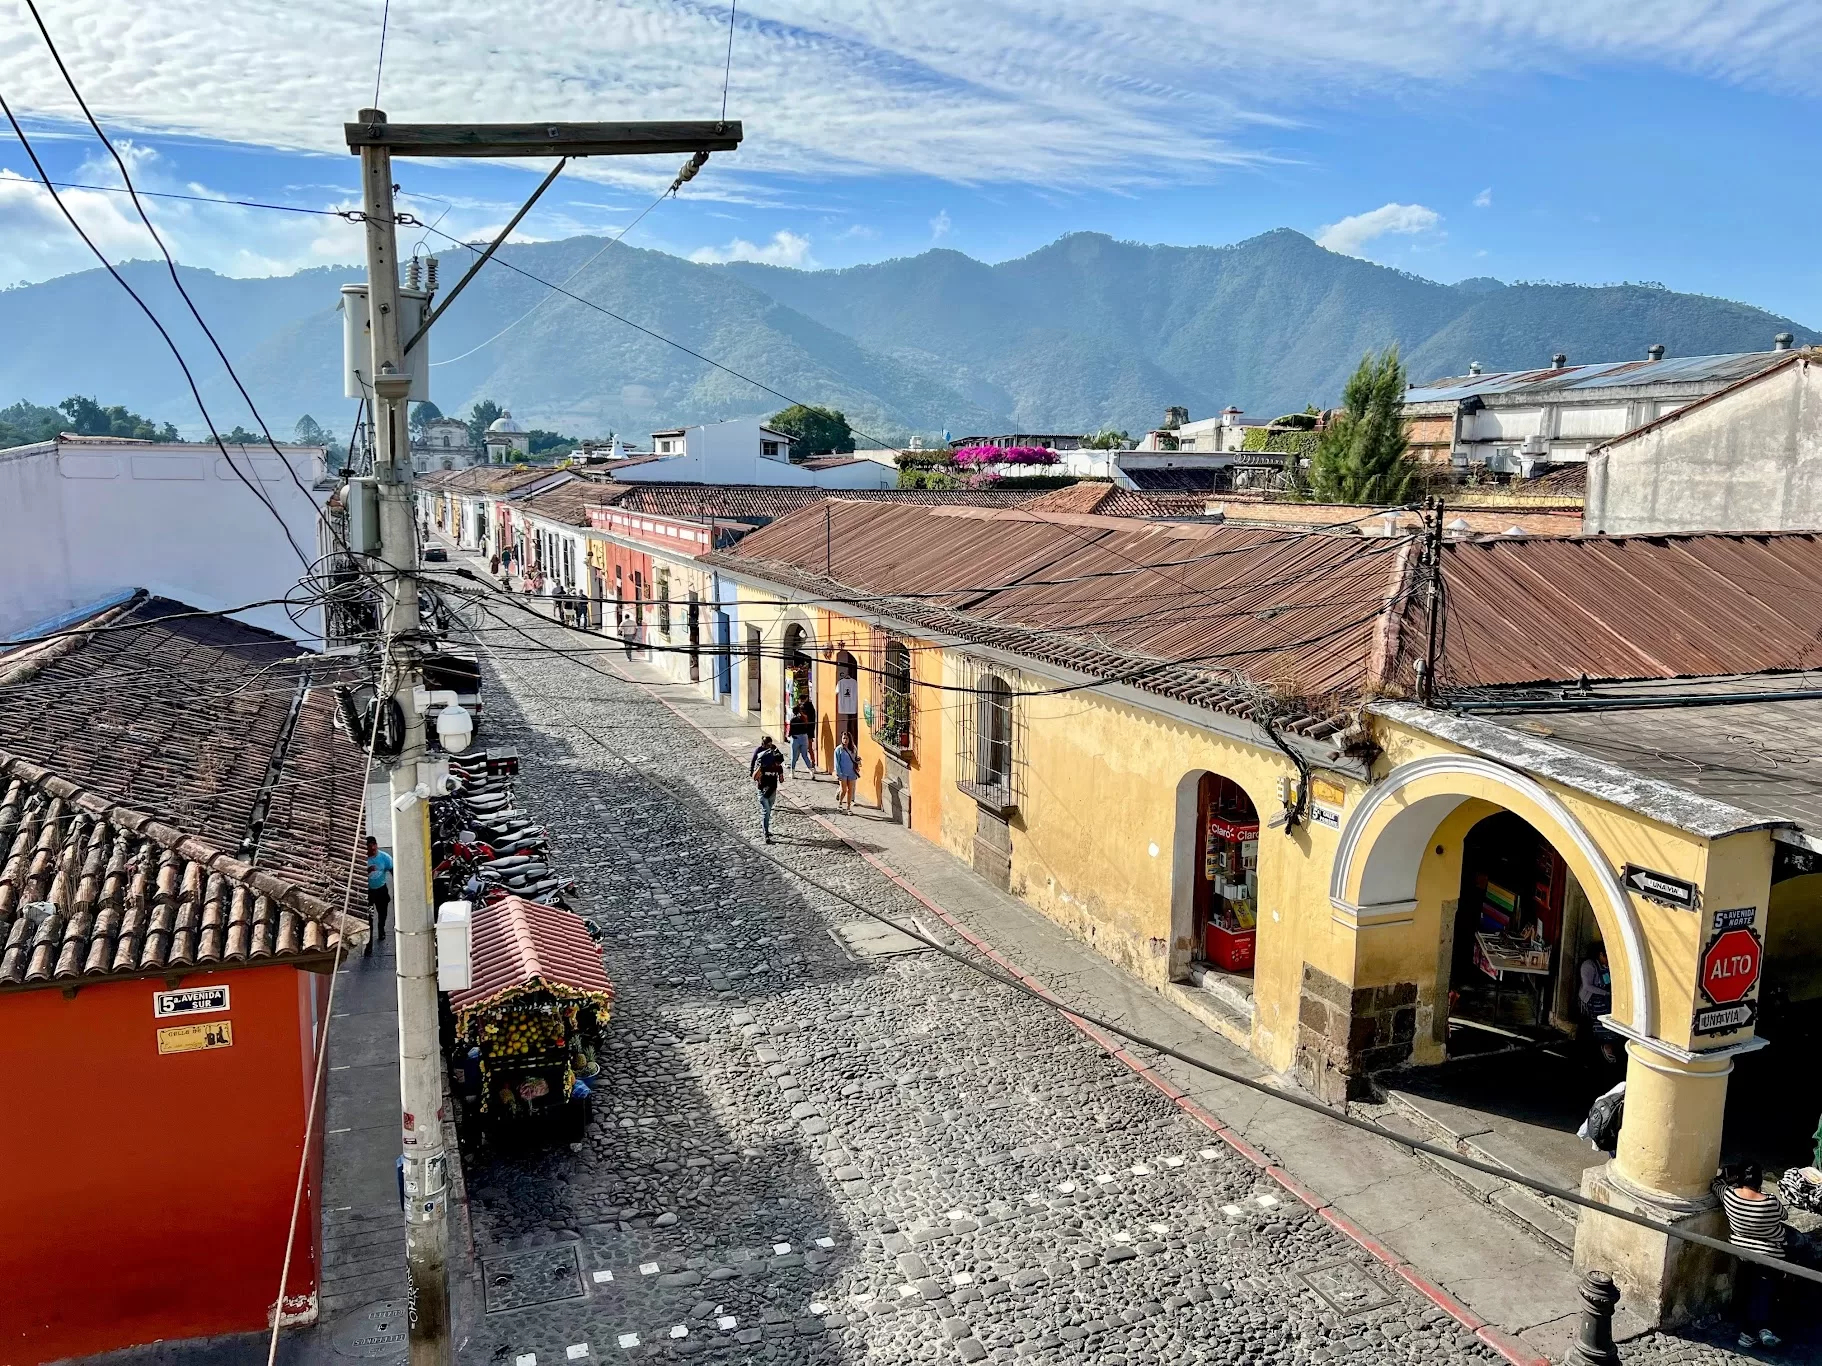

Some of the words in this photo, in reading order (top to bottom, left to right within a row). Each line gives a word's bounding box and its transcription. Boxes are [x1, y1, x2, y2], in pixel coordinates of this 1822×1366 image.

[1211, 823, 1231, 838] Claro
[1652, 881, 1666, 890] UNA
[1667, 886, 1678, 894] VIA
[1728, 909, 1754, 919] AVENIDA
[1728, 917, 1752, 927] NORTE
[1710, 954, 1752, 980] ALTO
[181, 991, 221, 1002] AVENIDA
[192, 1000, 212, 1009] SUR
[1703, 1013, 1721, 1027] UNA
[1725, 1009, 1739, 1023] VIA
